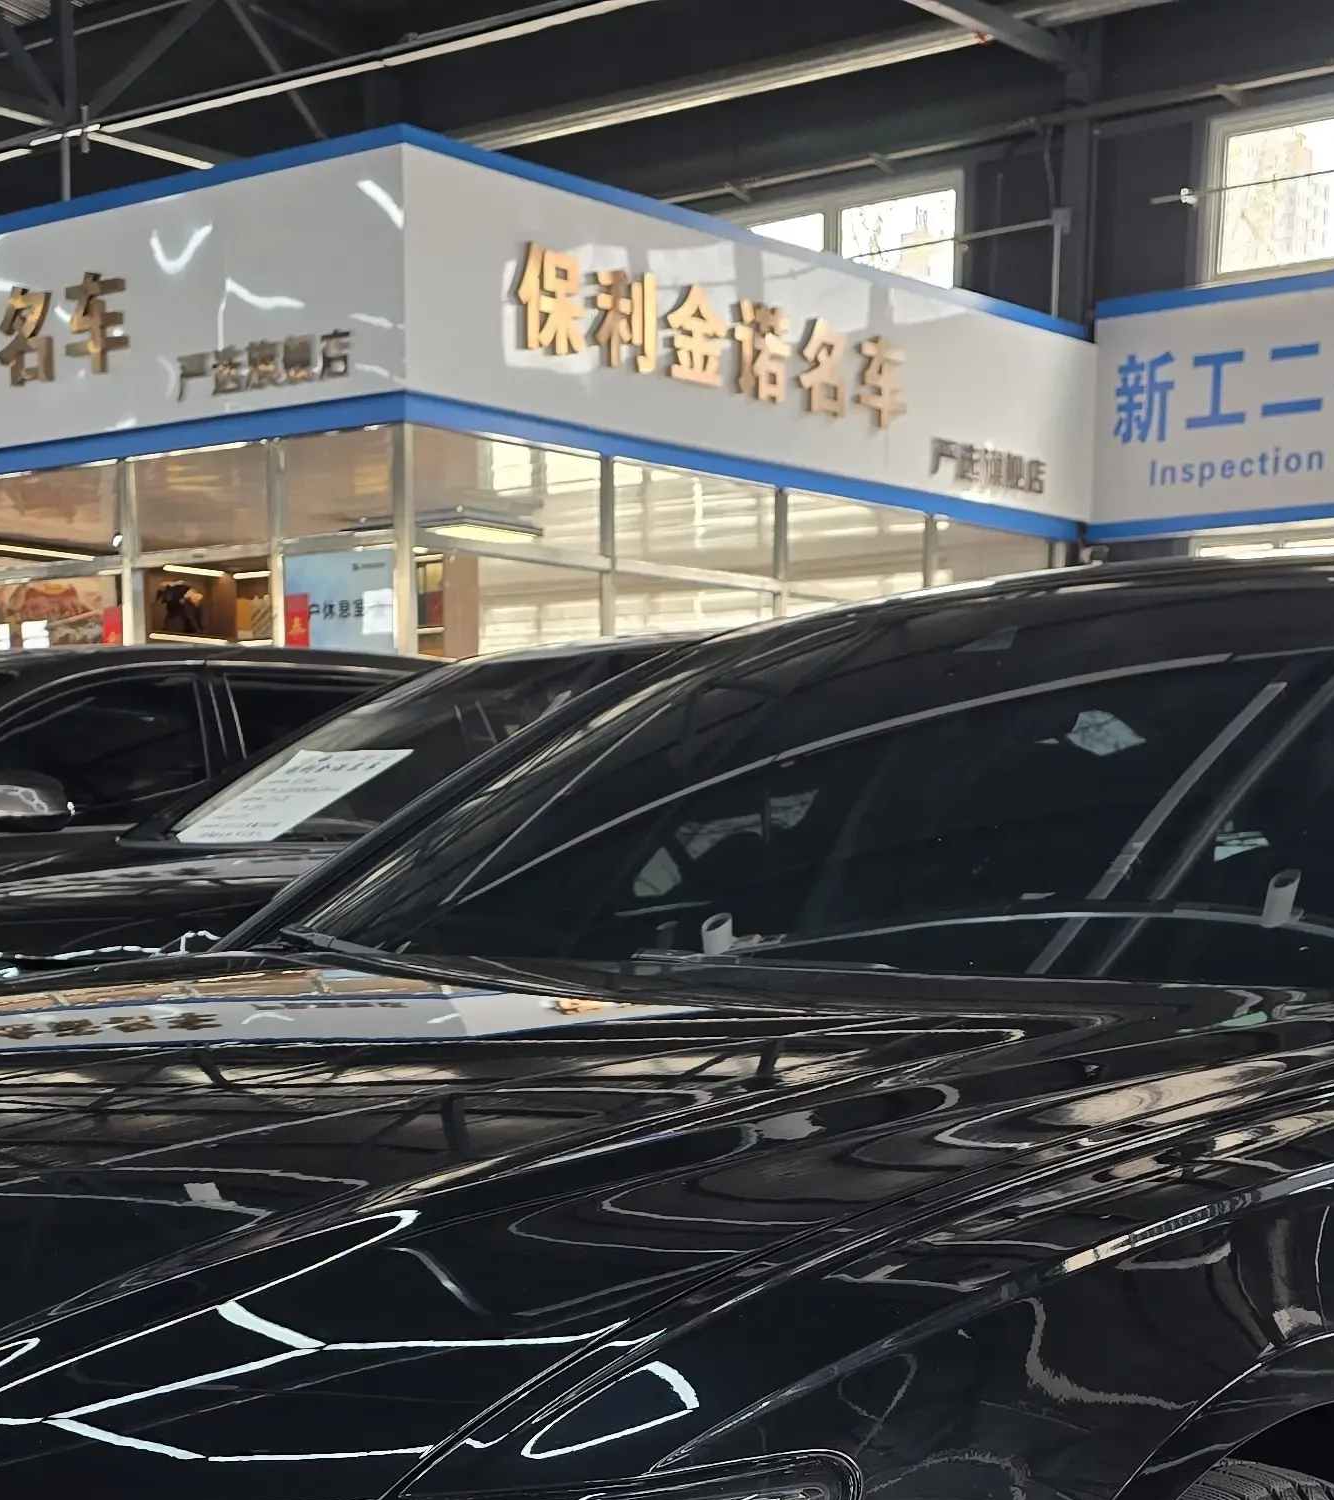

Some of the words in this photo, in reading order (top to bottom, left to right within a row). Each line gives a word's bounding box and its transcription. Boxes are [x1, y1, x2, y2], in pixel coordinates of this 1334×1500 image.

[518, 240, 908, 430] 保利金诺名车
[1149, 445, 1324, 487] Inspection
